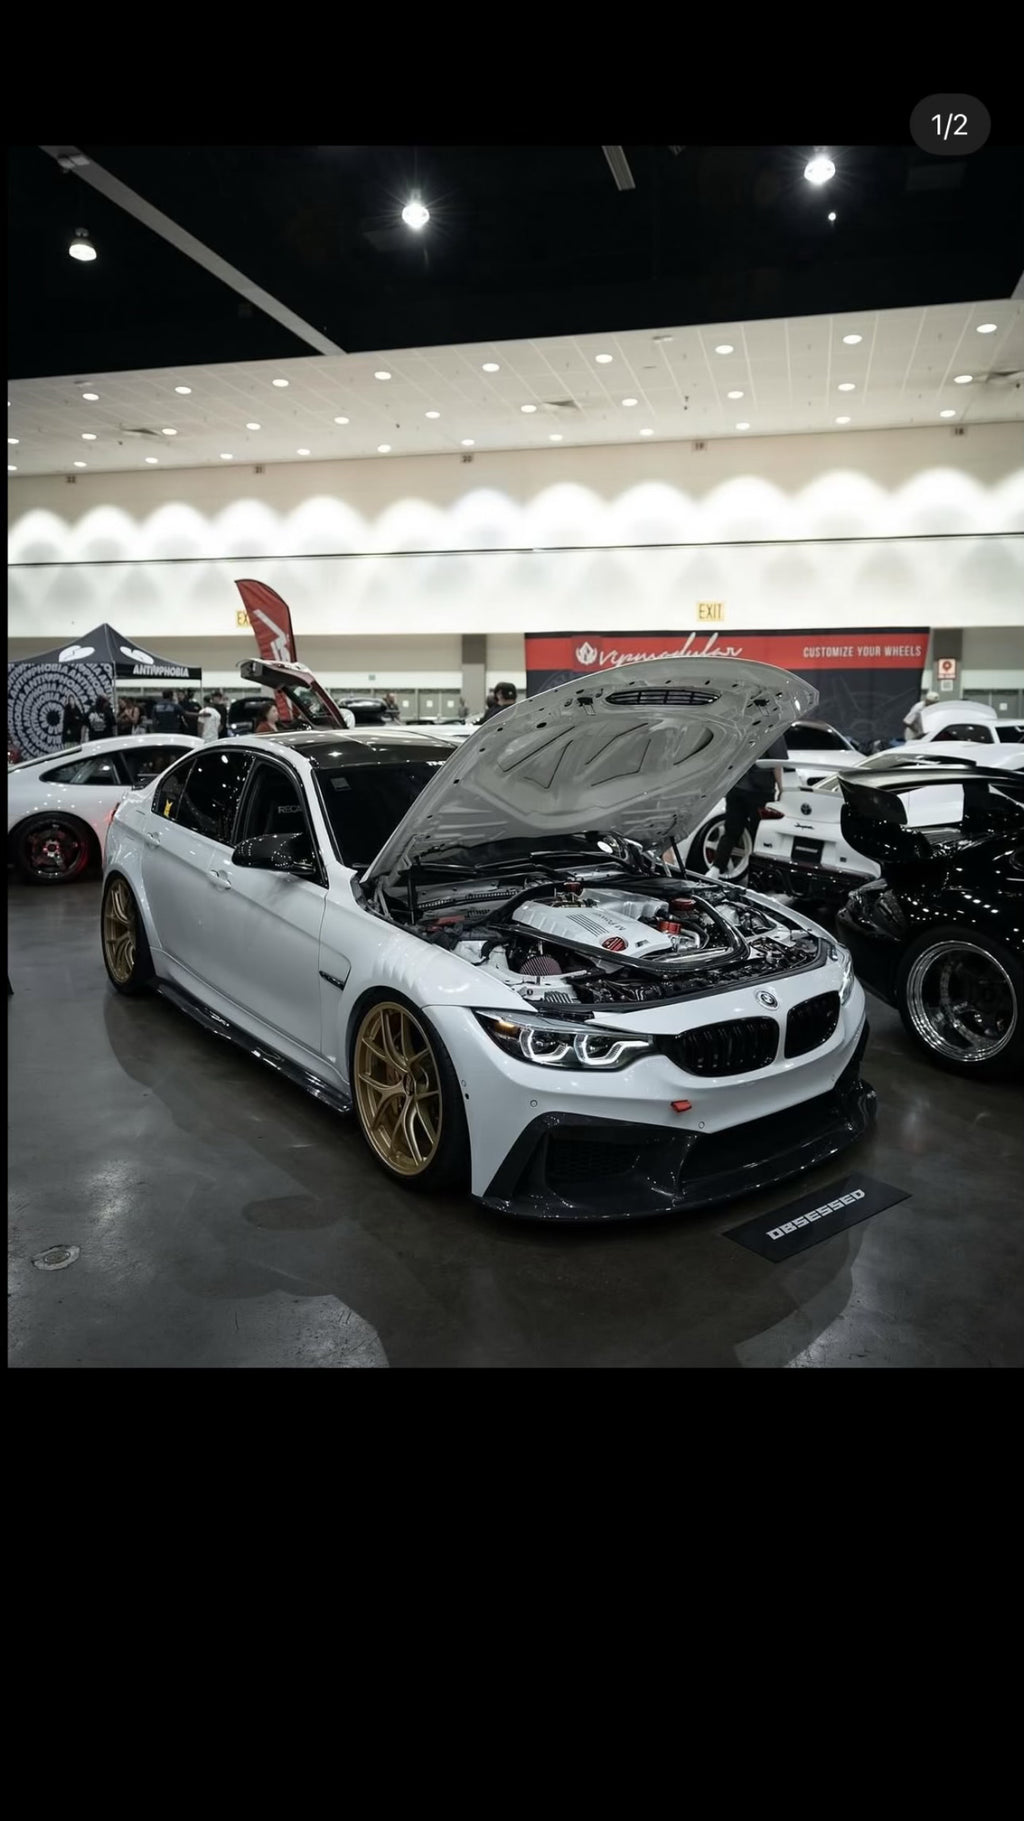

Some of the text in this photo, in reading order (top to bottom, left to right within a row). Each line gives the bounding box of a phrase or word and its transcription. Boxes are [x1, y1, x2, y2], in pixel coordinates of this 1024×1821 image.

[699, 603, 721, 619] EXIT
[803, 645, 922, 658] CUSTOMIZE YOUR WHEELS
[766, 1189, 866, 1240] OBSESSED
